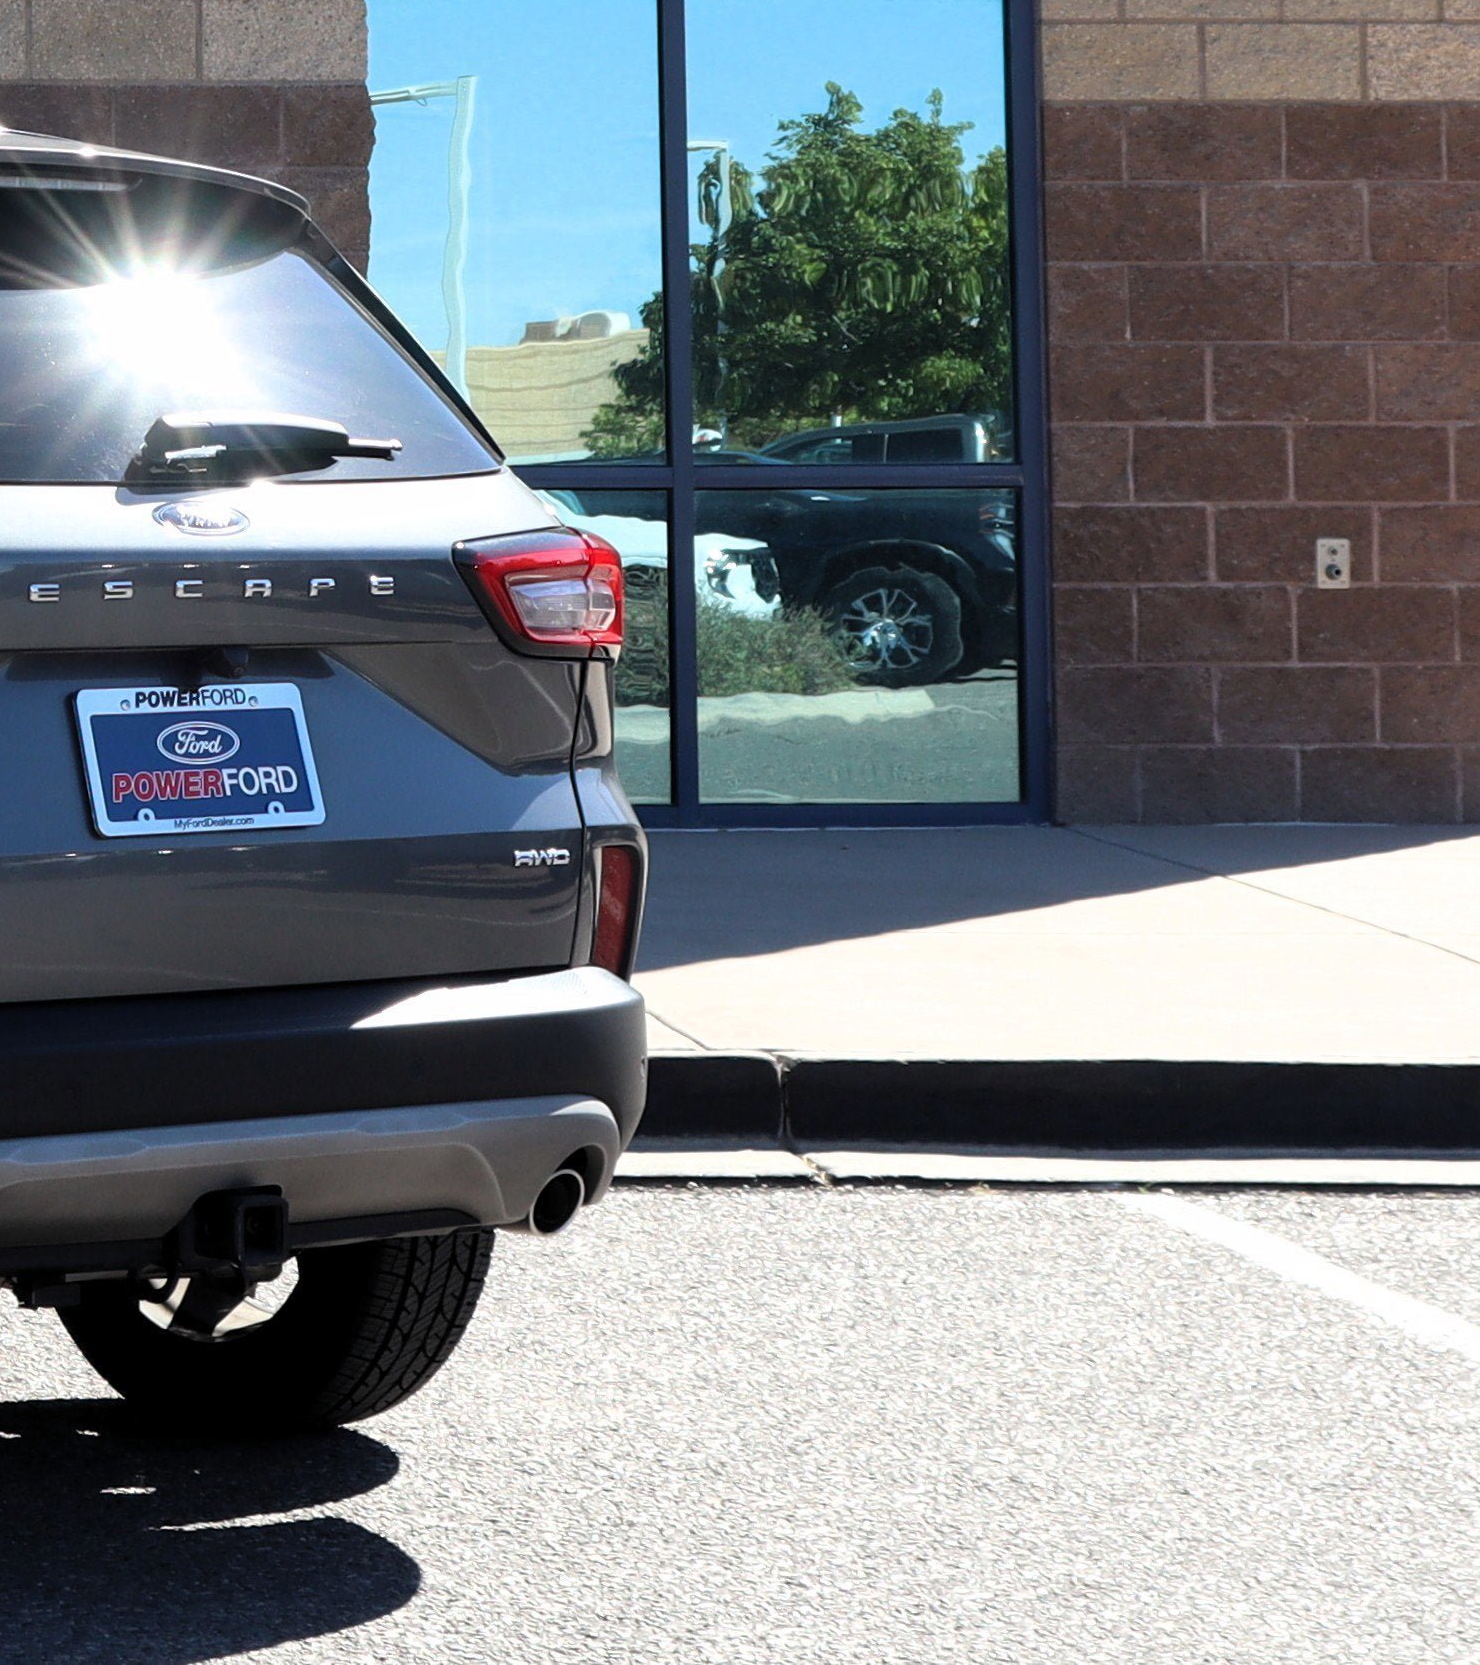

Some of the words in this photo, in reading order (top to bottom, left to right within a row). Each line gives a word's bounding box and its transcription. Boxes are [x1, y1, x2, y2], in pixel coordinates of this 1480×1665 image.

[28, 574, 395, 603] ESCAPE
[135, 688, 246, 709] POWERFORD
[174, 729, 223, 755] Ford
[112, 765, 298, 803] POWERFORD
[514, 848, 571, 867] AWD
